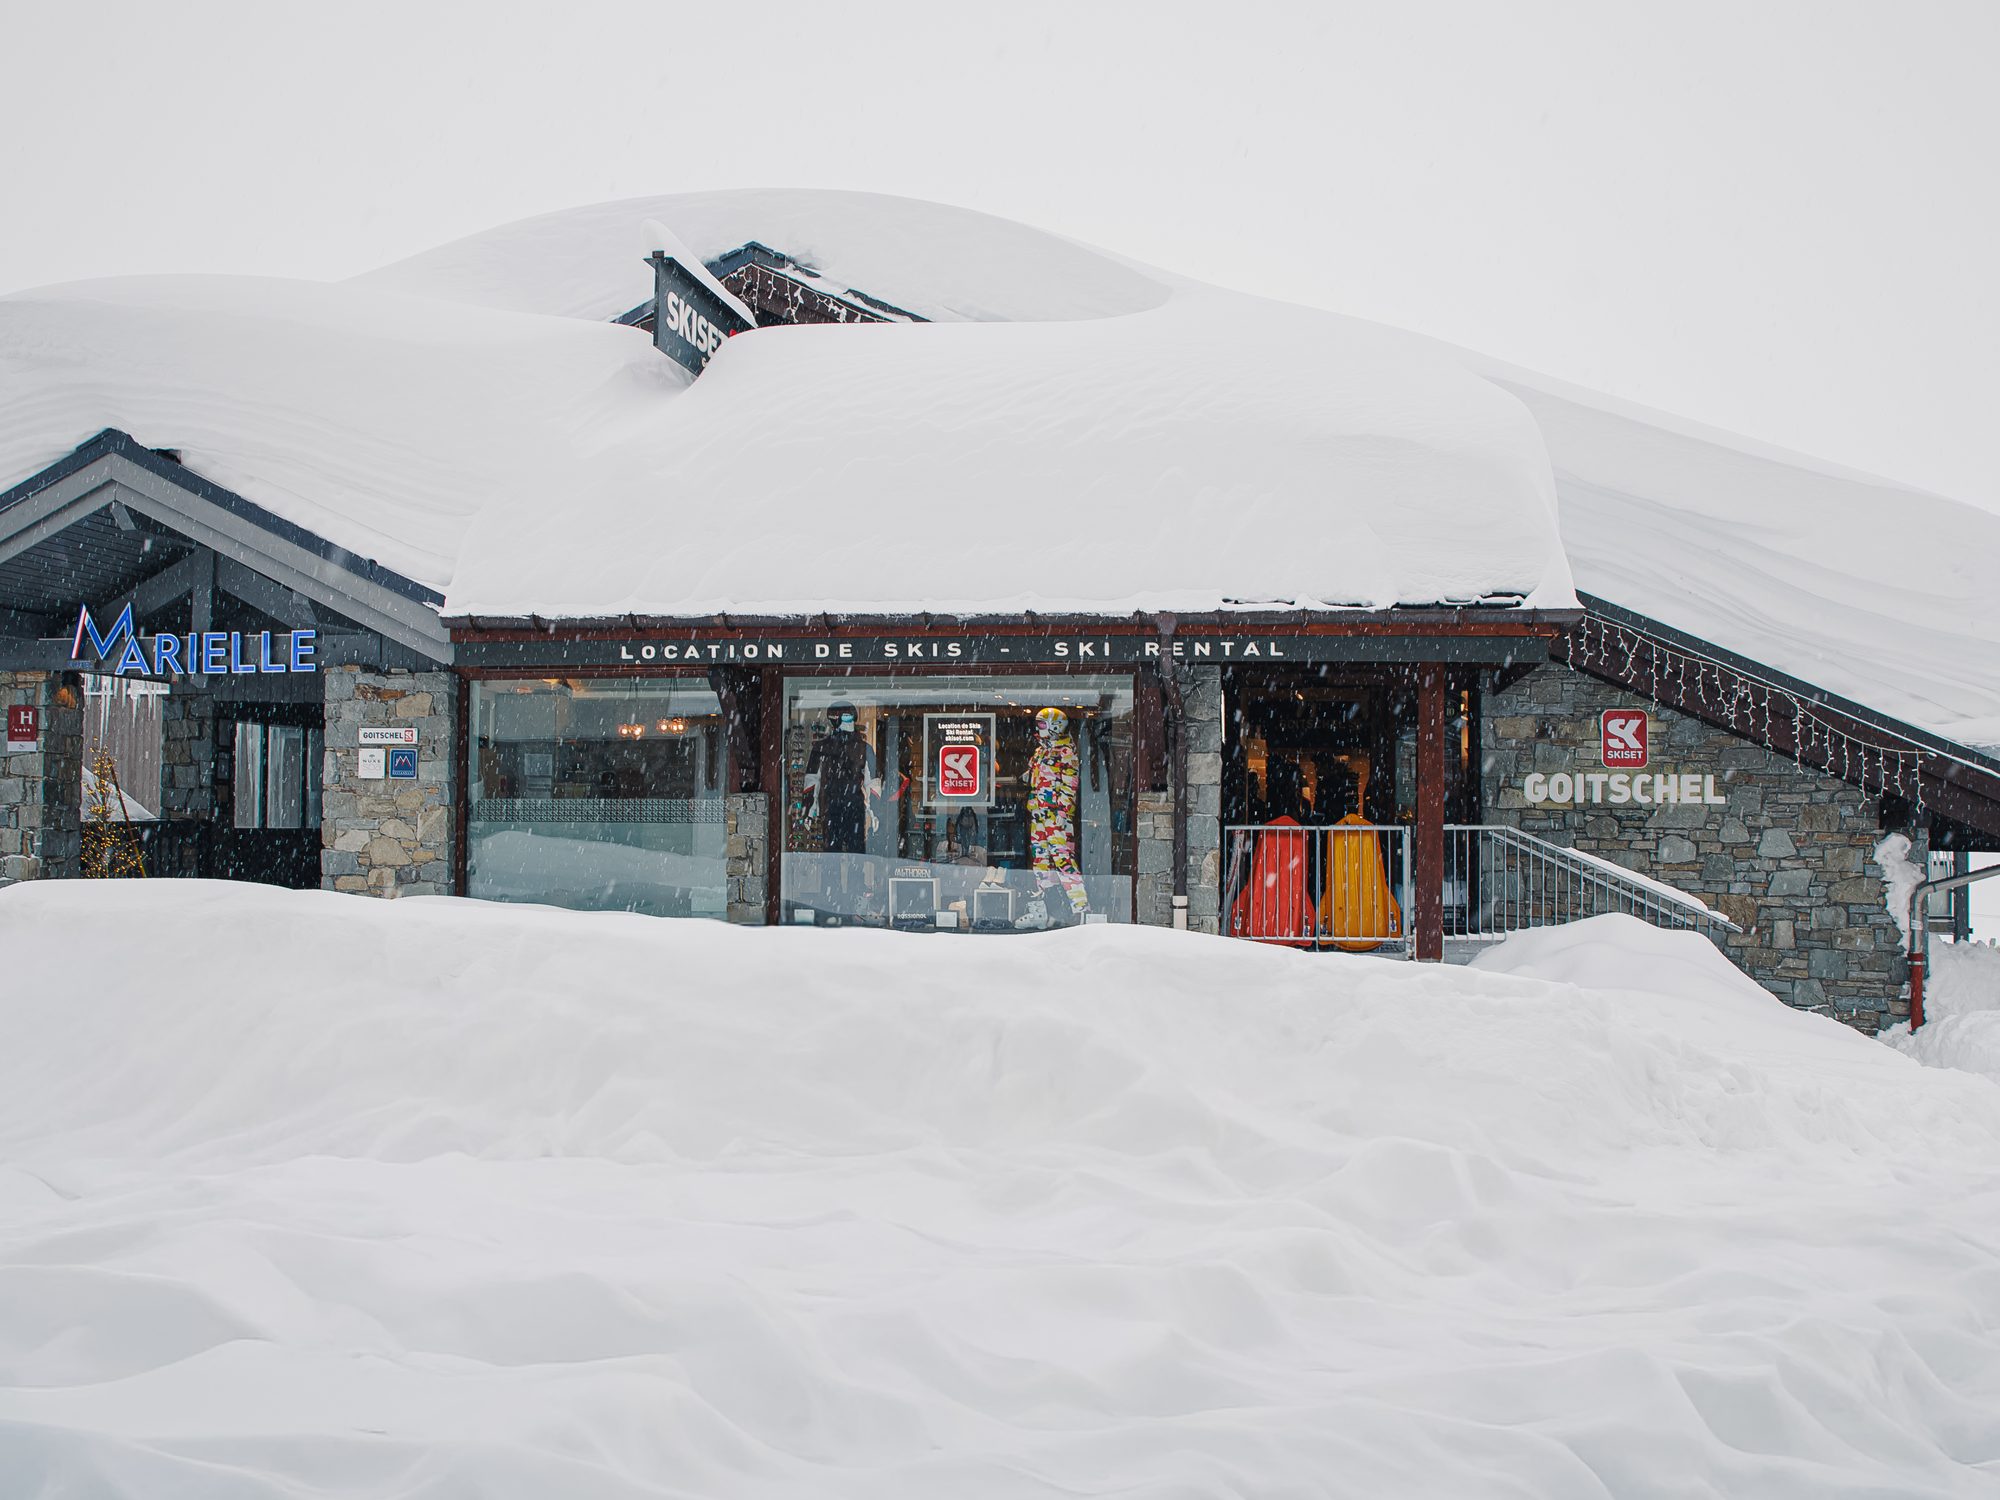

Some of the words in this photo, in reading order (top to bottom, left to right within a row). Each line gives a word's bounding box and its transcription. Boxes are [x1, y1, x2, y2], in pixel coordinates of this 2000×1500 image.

[666, 291, 729, 355] SKISE
[72, 601, 317, 675] MARIELLE
[621, 644, 783, 659] LOCATION
[815, 644, 852, 657] DE
[884, 643, 962, 657] SKIS
[1054, 642, 1110, 656] SKI
[1145, 642, 1284, 656] RENTAL
[20, 711, 33, 725] H
[363, 731, 404, 739] GOITSCHEL
[1607, 750, 1643, 759] SKISET
[1523, 772, 1726, 804] GOITSCHEL
